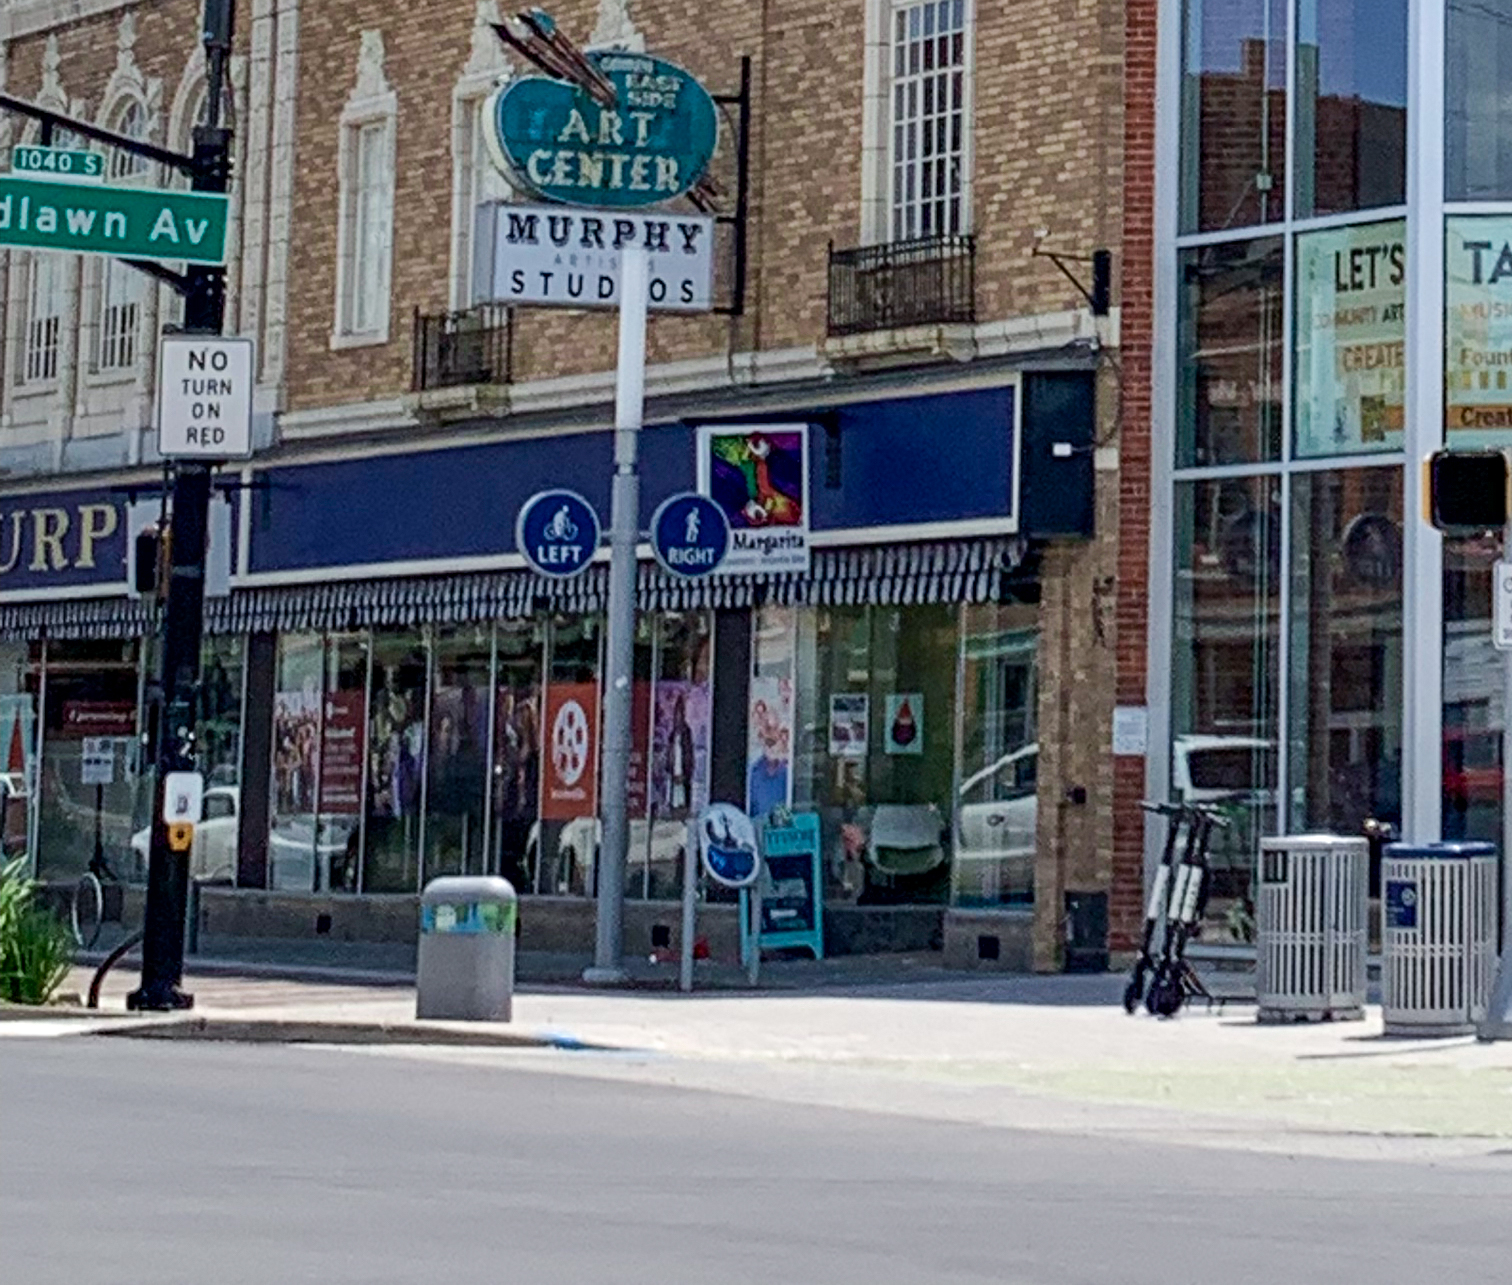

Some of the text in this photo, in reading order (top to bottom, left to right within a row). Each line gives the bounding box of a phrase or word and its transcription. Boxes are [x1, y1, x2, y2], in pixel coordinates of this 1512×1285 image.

[557, 107, 657, 148] ART
[20, 150, 98, 175] 1040 S
[527, 148, 681, 194] CENTER
[148, 207, 209, 245] Av
[505, 213, 703, 255] MURPHY
[553, 252, 657, 273] ARTISS
[1334, 243, 1405, 293] LET'S
[510, 269, 695, 304] STUDOS
[188, 350, 229, 371] NO
[1342, 340, 1405, 373] CREATE
[181, 378, 233, 396] TURN
[191, 401, 221, 420] ON
[186, 426, 226, 448] RED
[536, 544, 583, 565] LEFT
[667, 546, 716, 566] RIGHT
[732, 528, 805, 557] Margarita
